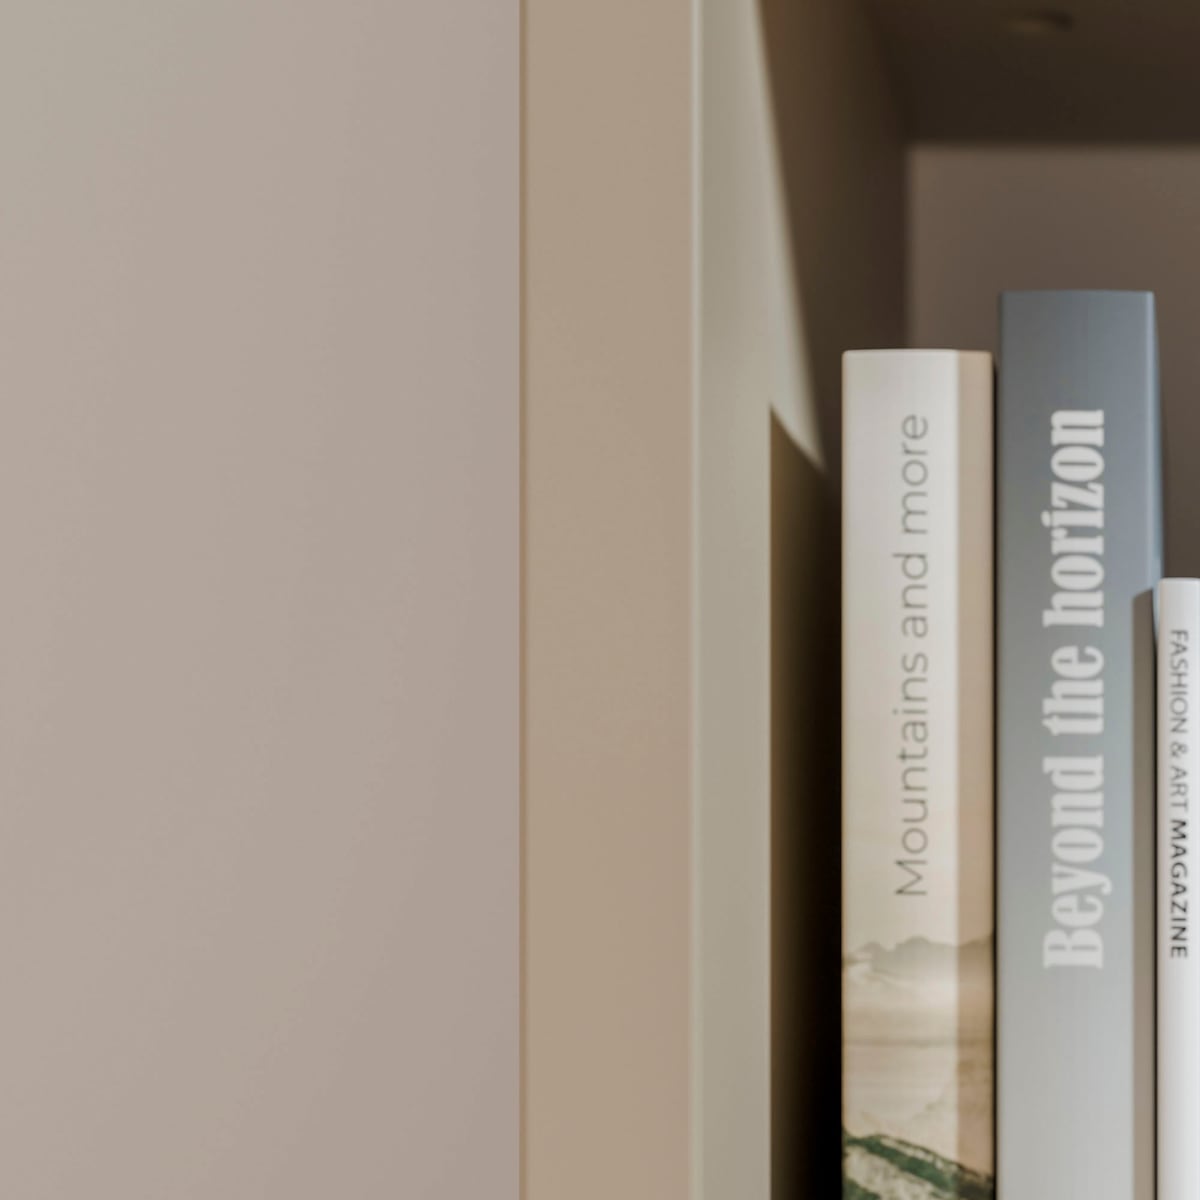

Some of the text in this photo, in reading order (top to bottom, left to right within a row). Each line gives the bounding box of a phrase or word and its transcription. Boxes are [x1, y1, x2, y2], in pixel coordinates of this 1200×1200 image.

[892, 413, 929, 896] Mountains and more
[1041, 409, 1113, 970] Beyond the horizon
[1169, 629, 1189, 959] FASHION & ART MAGAZINE
